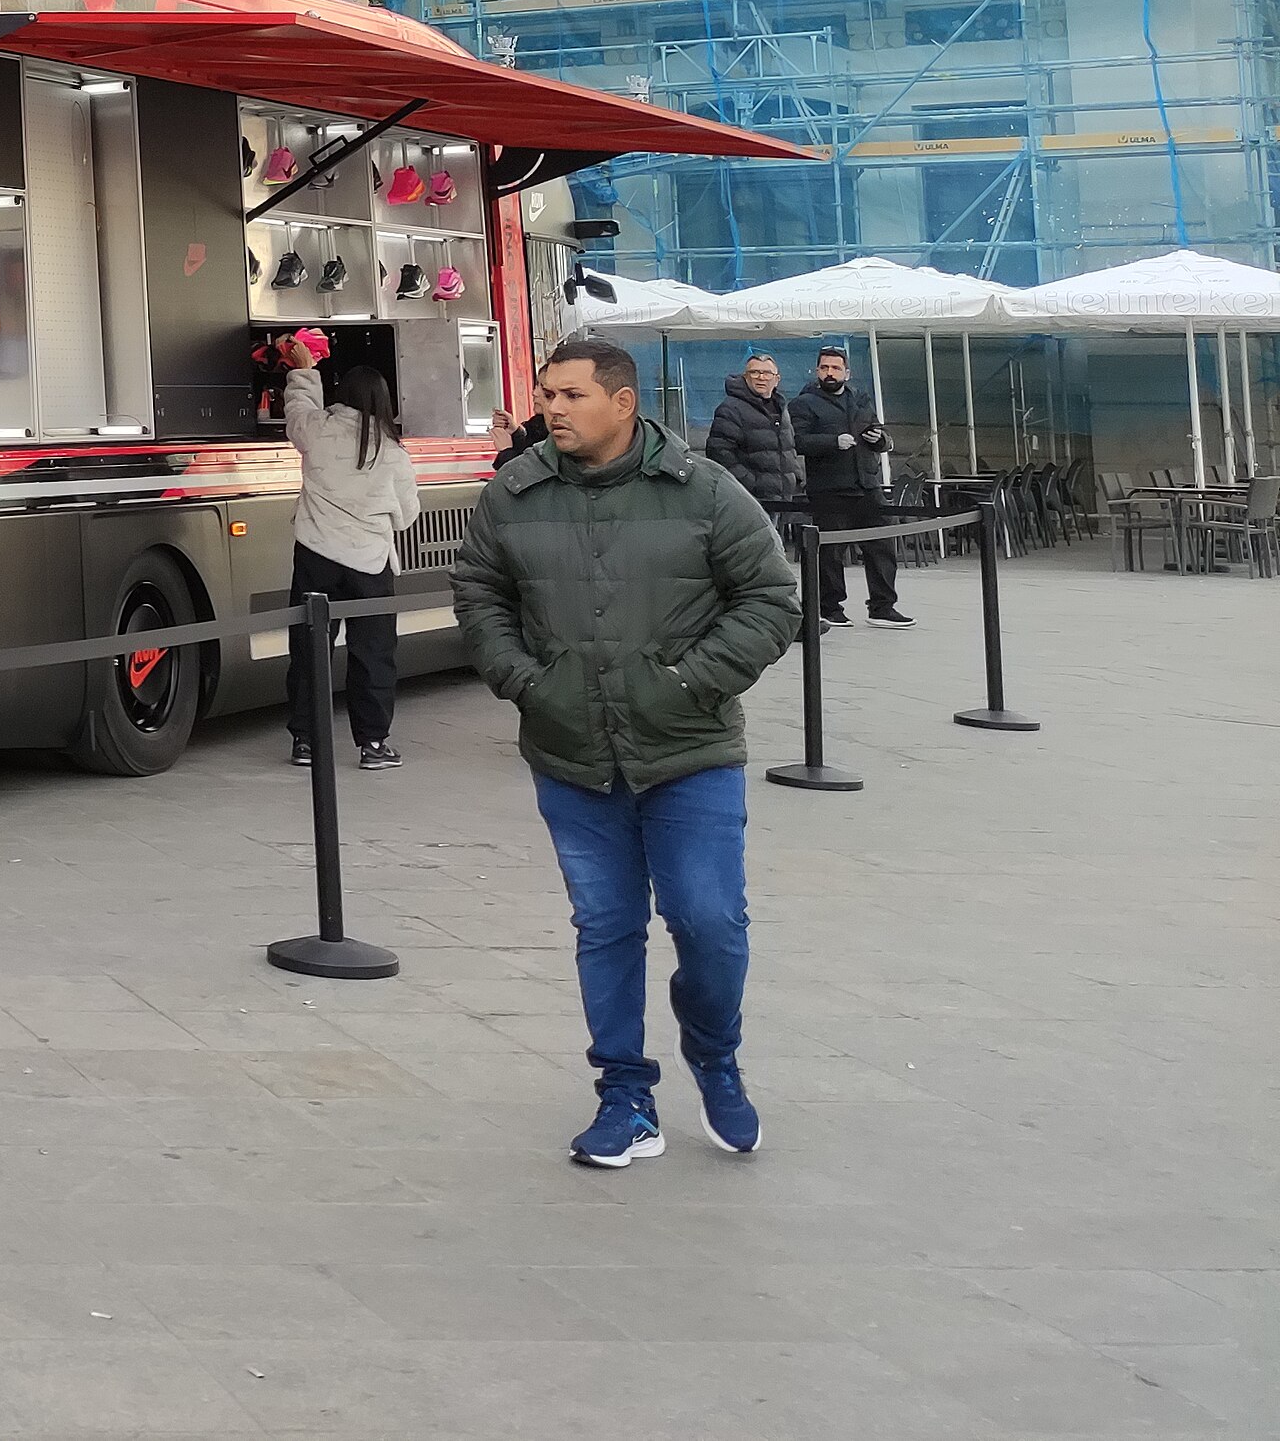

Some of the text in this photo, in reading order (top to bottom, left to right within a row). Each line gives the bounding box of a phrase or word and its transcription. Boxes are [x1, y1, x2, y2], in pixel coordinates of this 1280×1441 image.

[1129, 135, 1156, 144] ULMA
[925, 142, 949, 151] ULMA
[1033, 289, 1280, 316] Heineke
